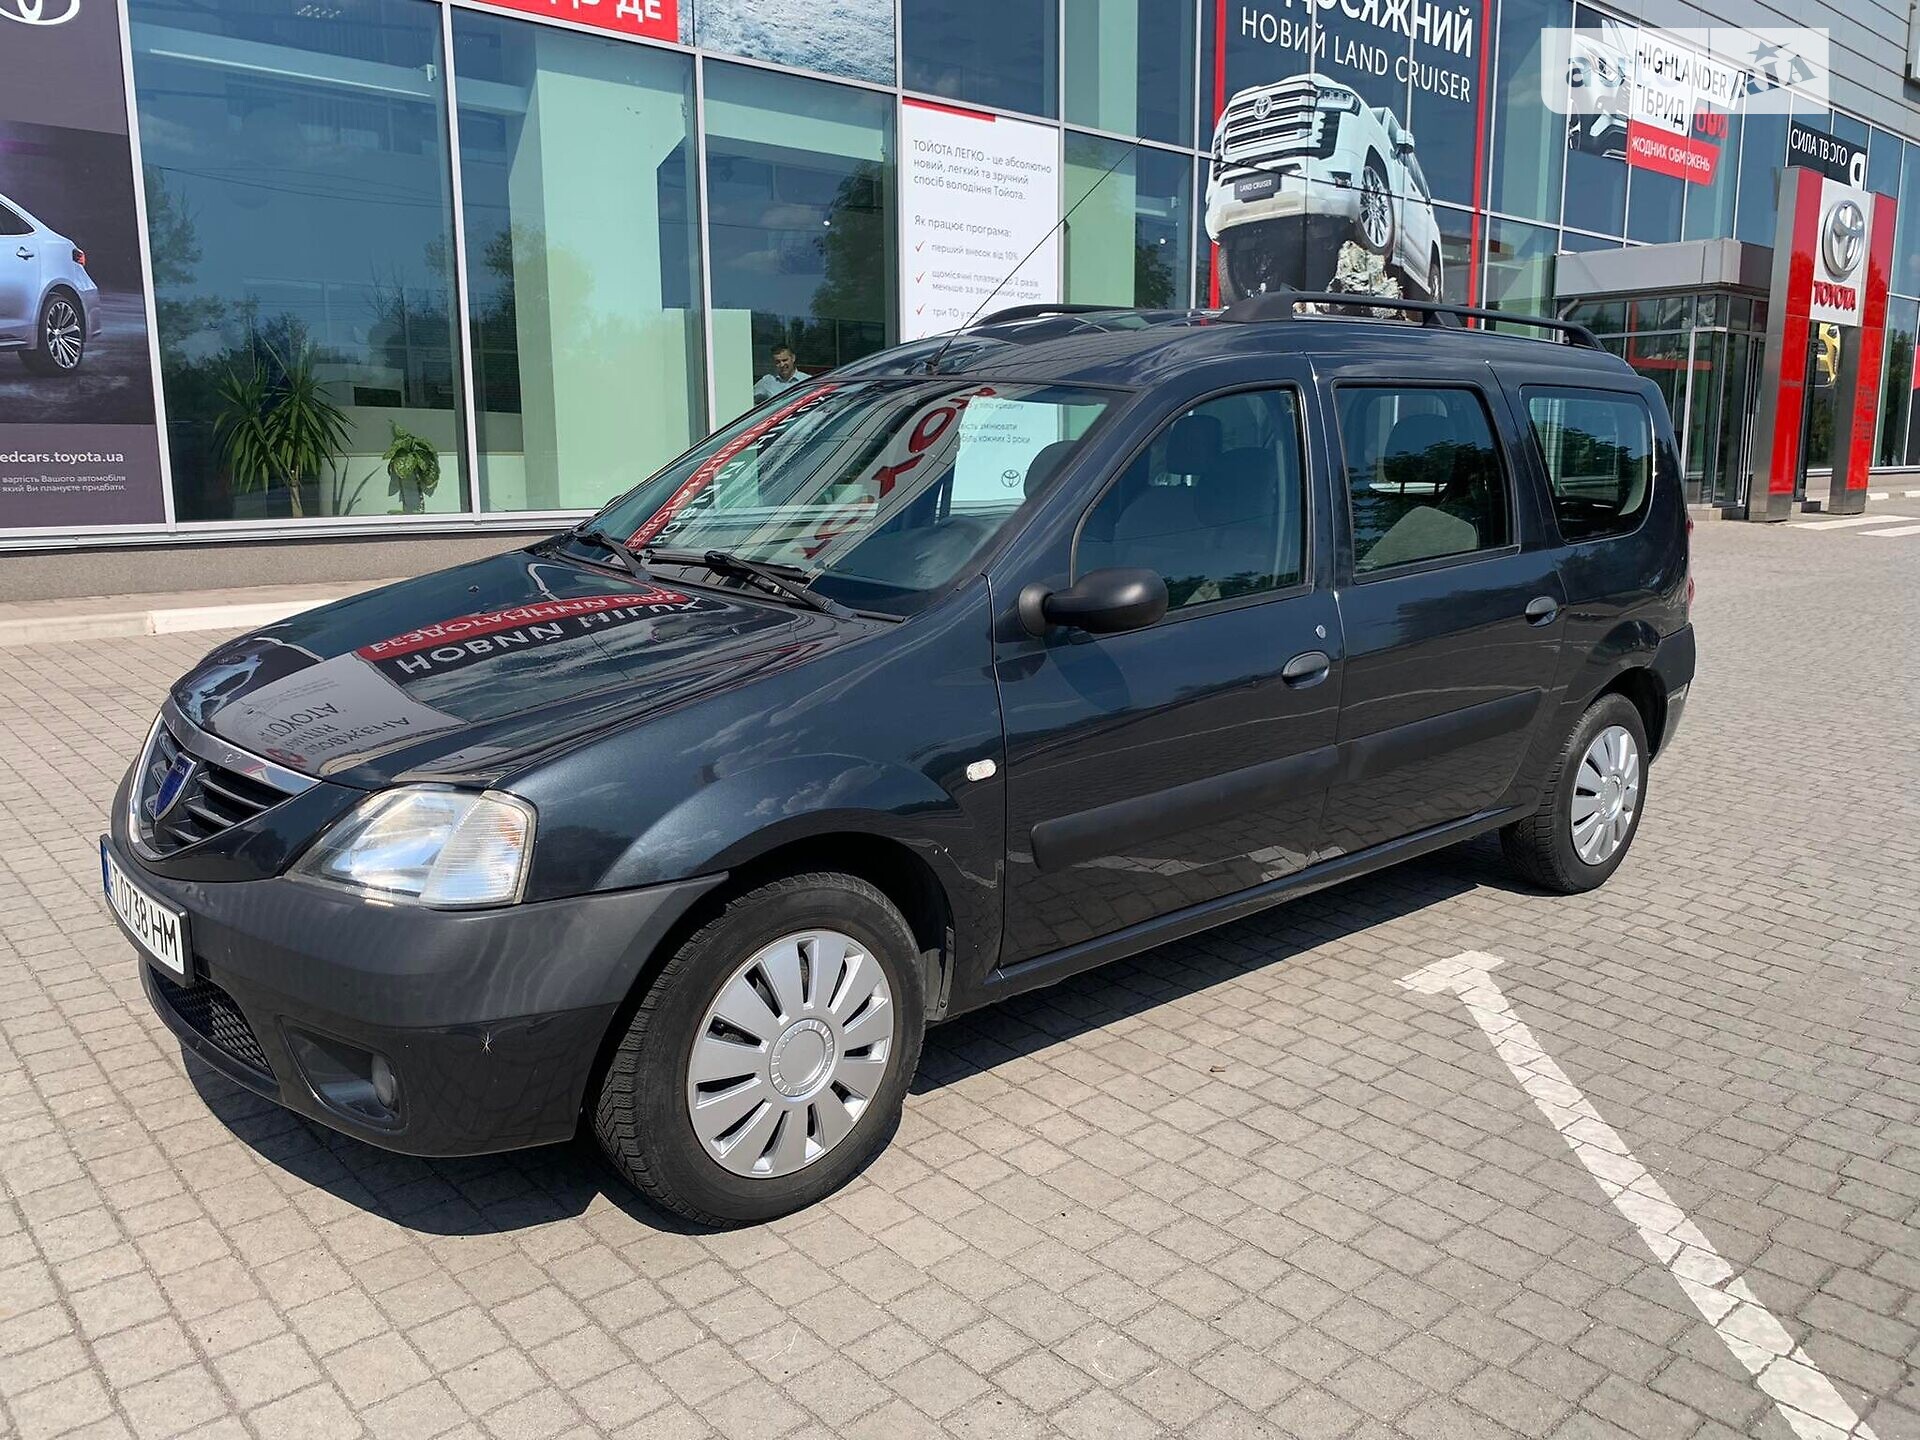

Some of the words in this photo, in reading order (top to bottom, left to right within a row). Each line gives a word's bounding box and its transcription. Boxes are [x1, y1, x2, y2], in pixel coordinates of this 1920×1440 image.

[1241, 6, 1326, 59] НОВИЙ
[1334, 36, 1388, 76] LAND
[1395, 56, 1471, 104] CRUISER
[1638, 42, 1727, 99] HIGHLANDER
[1631, 136, 1668, 160] ЖОДНИХ
[1791, 128, 1817, 156] СИЛА
[913, 139, 953, 157] ТОЙОТА
[954, 147, 985, 162] ЛЕГКО
[992, 156, 1004, 167] це
[1005, 157, 1052, 174] абсолютно
[913, 158, 946, 173] новий,
[948, 164, 980, 179] легкий
[981, 170, 992, 180] та
[992, 172, 1029, 186] зручний
[913, 174, 945, 188] спосіб
[946, 180, 993, 195] володіння
[993, 185, 1027, 201] Тойота.
[1239, 184, 1254, 193] LAND
[914, 214, 926, 226] Як
[928, 218, 965, 232] працює
[965, 223, 1013, 239] програма:
[931, 243, 965, 256] перший
[965, 247, 992, 259] внесок
[1813, 280, 1857, 312] TOYOTA
[0, 450, 125, 465] edcars.toyota.ua
[2, 474, 40, 484] вартість
[41, 474, 76, 484] Вашого
[76, 473, 127, 483] автомобіля
[2, 485, 25, 493] який
[26, 484, 39, 493] Ви
[120, 875, 149, 939] 0738
